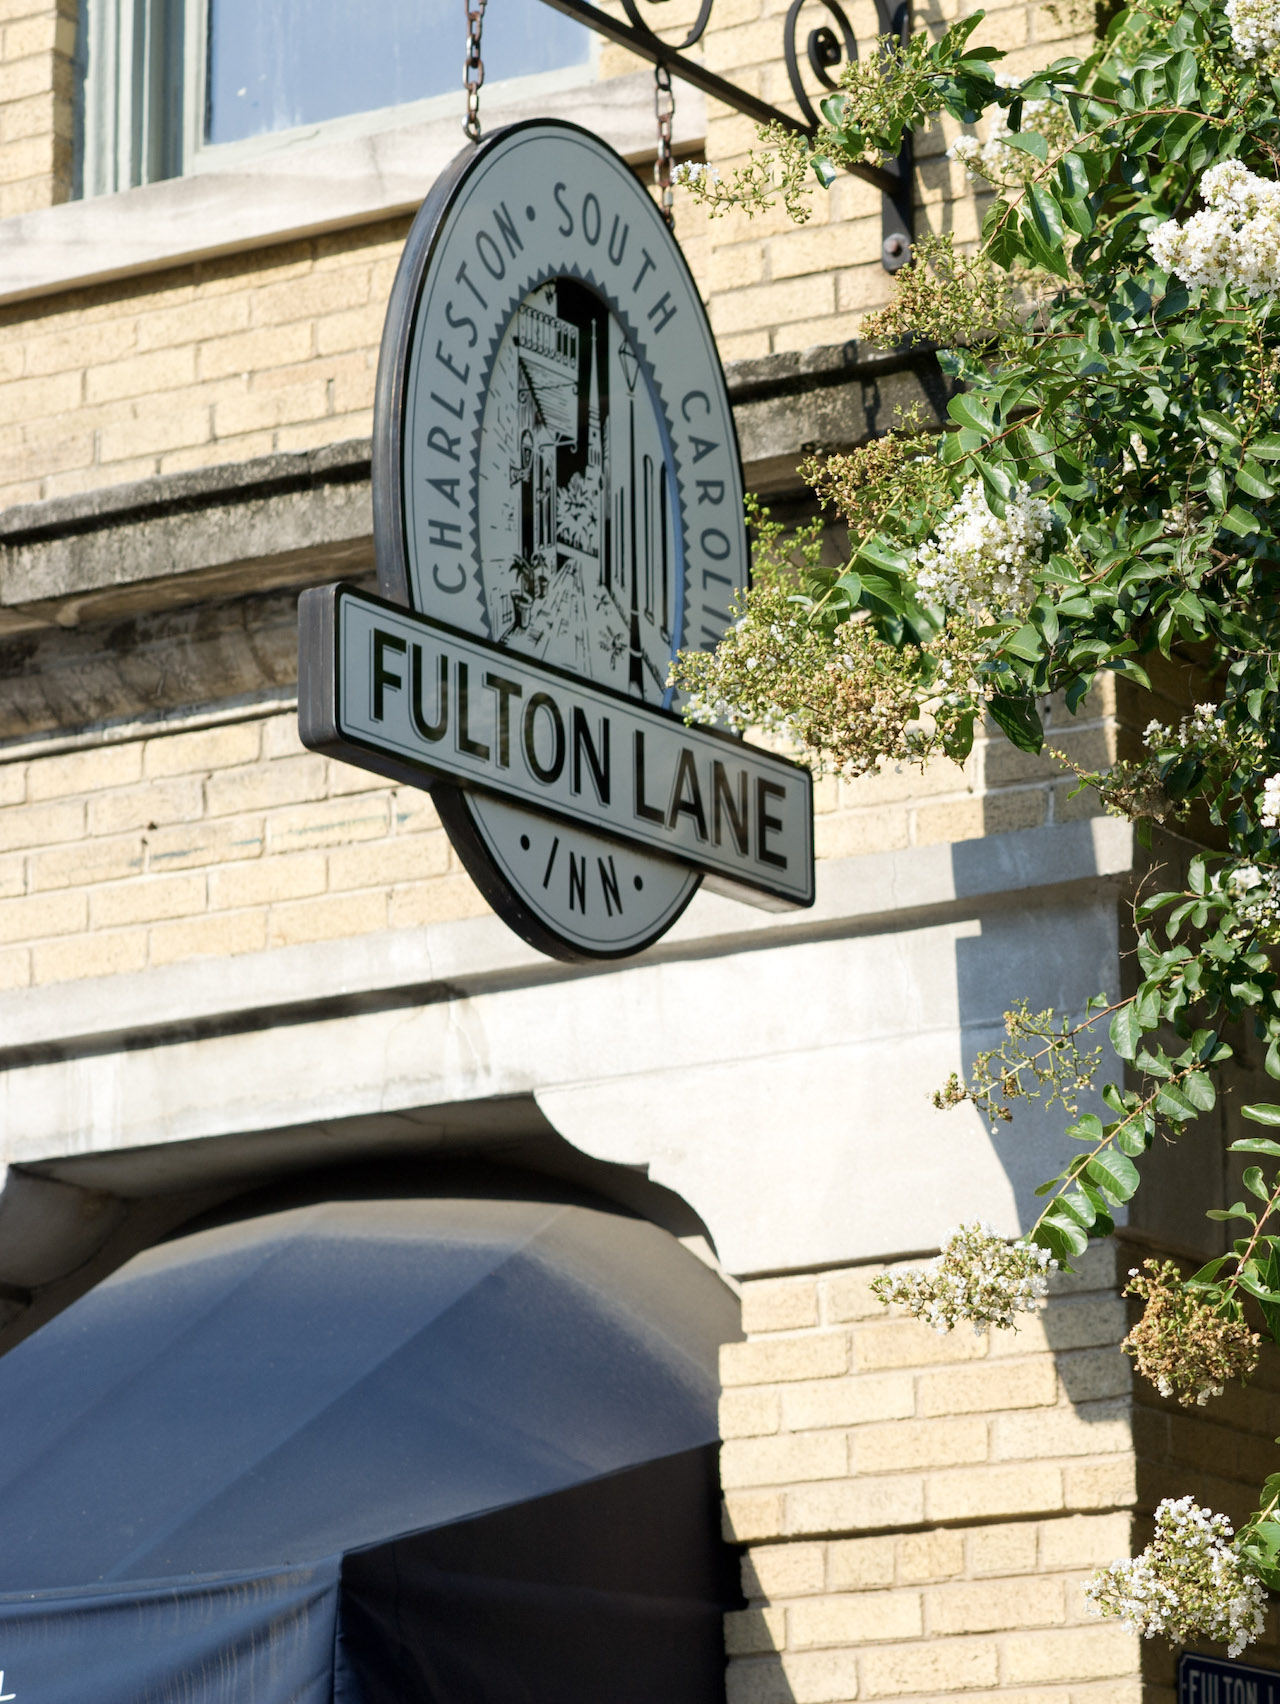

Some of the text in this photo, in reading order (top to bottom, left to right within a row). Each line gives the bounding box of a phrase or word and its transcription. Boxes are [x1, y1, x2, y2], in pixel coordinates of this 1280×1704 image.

[425, 181, 733, 656] CHARLESTON SOUTH CAROLIN
[369, 627, 788, 872] FULTON LANE
[542, 836, 623, 917] INN
